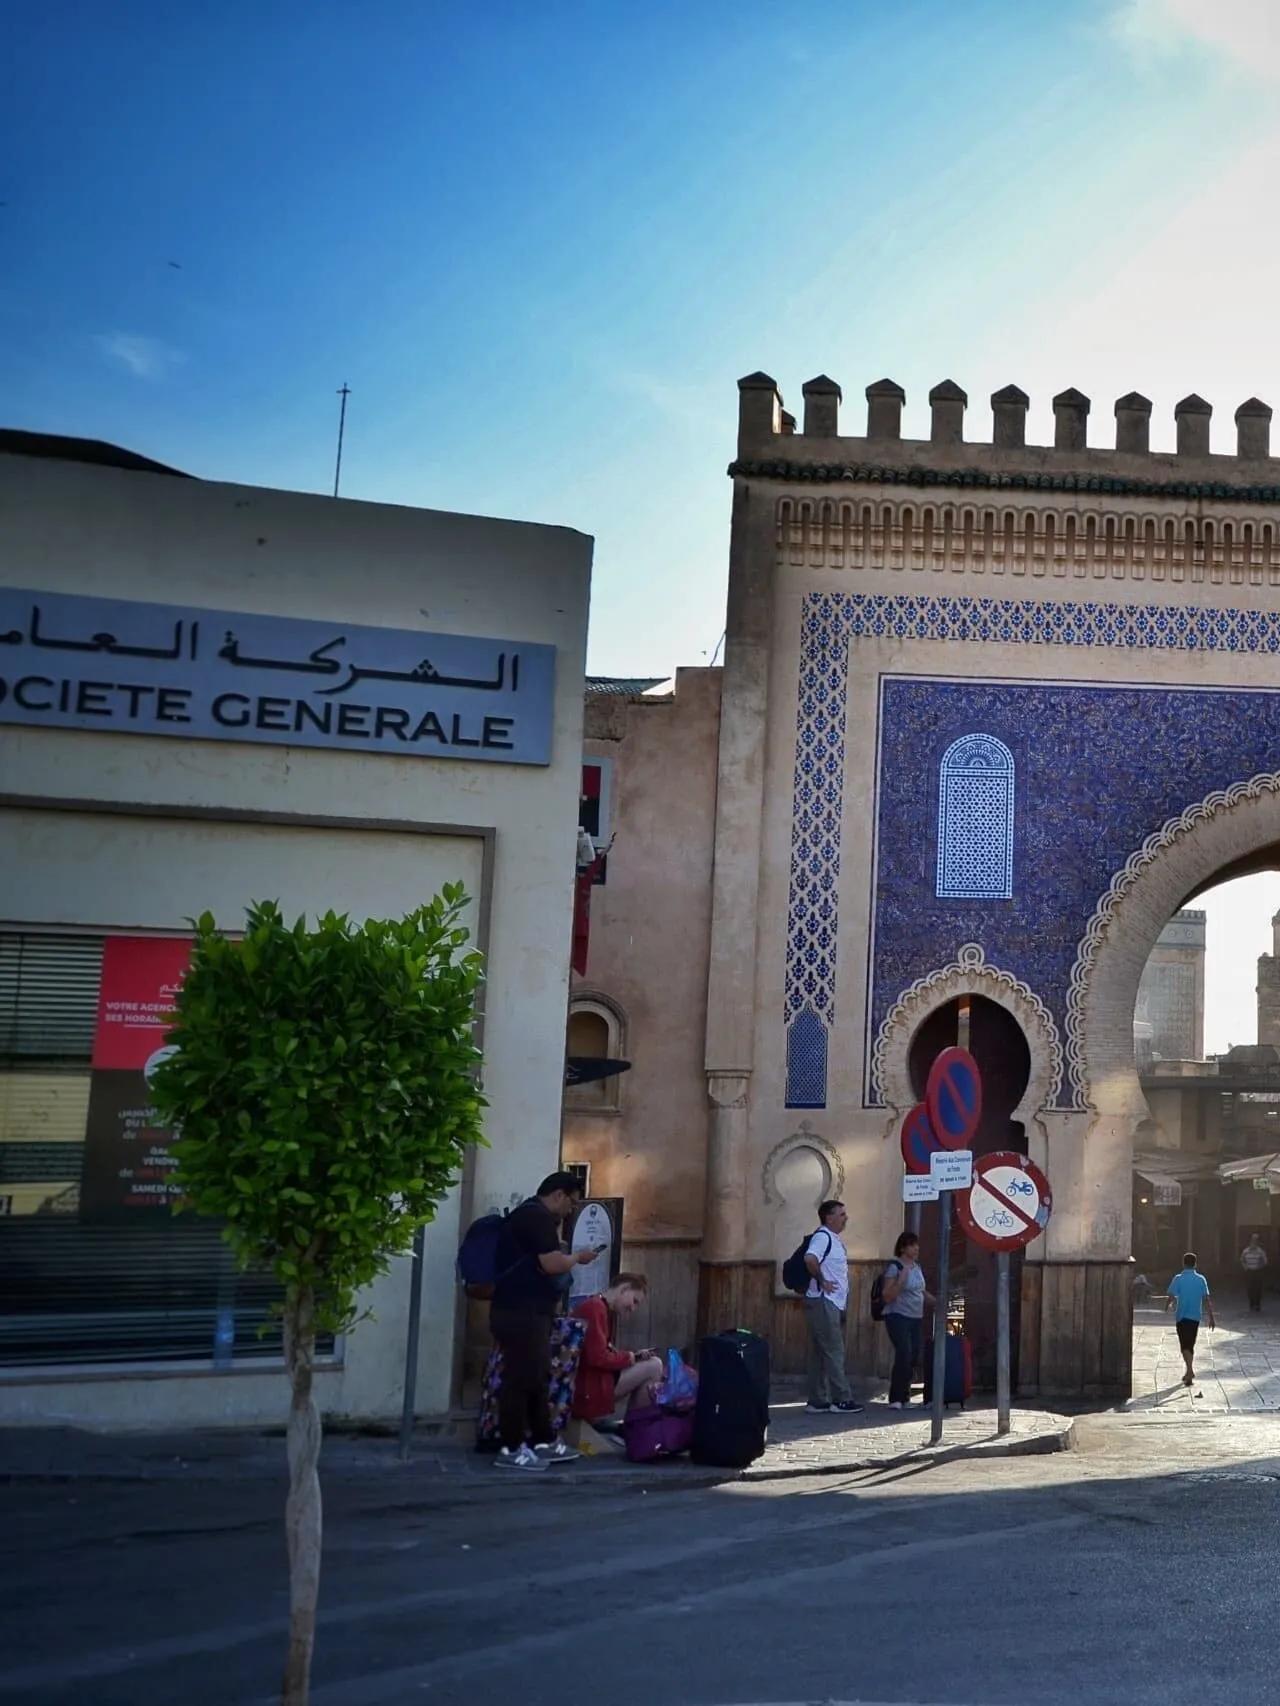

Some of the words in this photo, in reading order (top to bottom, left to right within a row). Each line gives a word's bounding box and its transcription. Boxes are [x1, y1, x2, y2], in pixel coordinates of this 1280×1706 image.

[0, 605, 198, 661] العام
[217, 630, 519, 695] الشركة
[0, 675, 193, 723] CIETE
[210, 692, 515, 750] GENERALE
[106, 1001, 138, 1011] VOTRE
[124, 1014, 161, 1023] HORAI
[131, 1184, 167, 1193] SAMEDI
